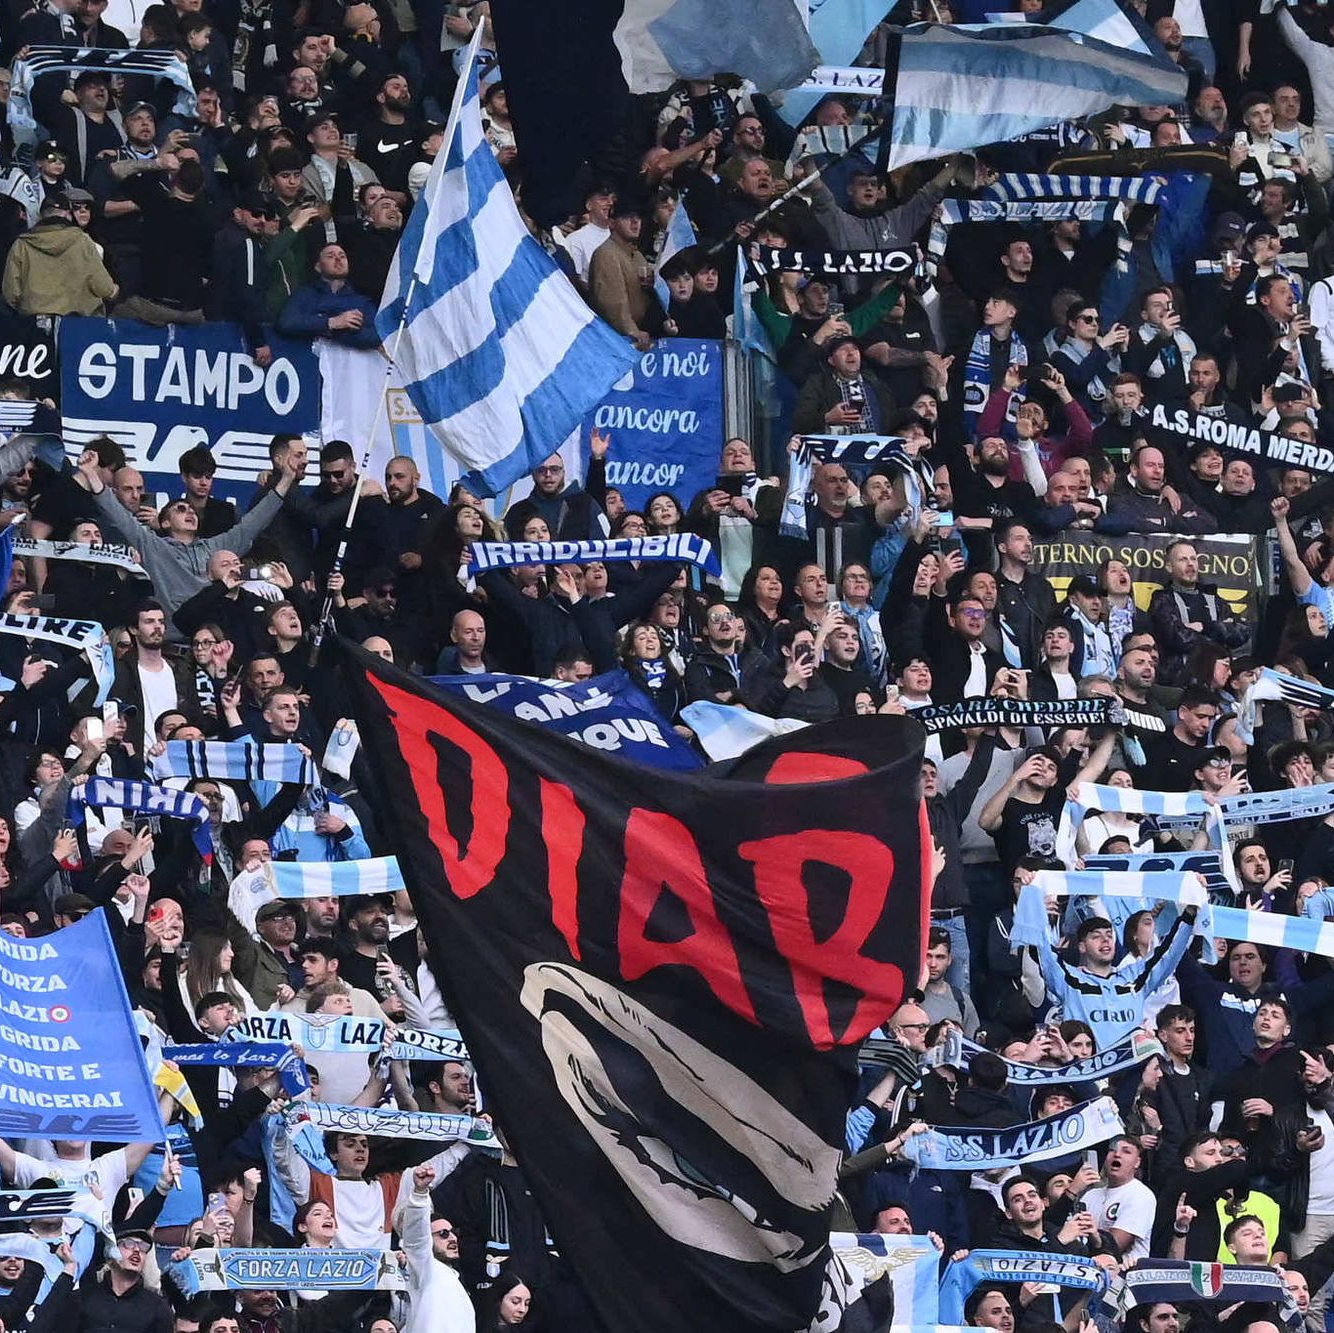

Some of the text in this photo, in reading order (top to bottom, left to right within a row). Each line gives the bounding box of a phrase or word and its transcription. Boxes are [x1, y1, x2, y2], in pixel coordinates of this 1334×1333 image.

[823, 252, 913, 274] LAZIO
[640, 344, 711, 378] e noi
[78, 341, 301, 416] STAMPO
[594, 404, 701, 437] ancora
[1152, 403, 1262, 455] A.S.ROMA
[471, 532, 710, 569] IRRIDUCIBILI
[921, 697, 1107, 718] OSARE CREDERE
[924, 710, 1108, 733] SPAVALDI DI ESSERE!
[1087, 1008, 1136, 1025] CIRIO
[0, 1024, 82, 1053] GRIDA
[81, 1061, 102, 1081] E
[1051, 1049, 1118, 1079] LAZIO
[995, 1113, 1086, 1161] LAZIO
[236, 1259, 366, 1279] FORZA LAZIO
[998, 1258, 1068, 1276] LAZIO
[1202, 1273, 1210, 1283] 2
